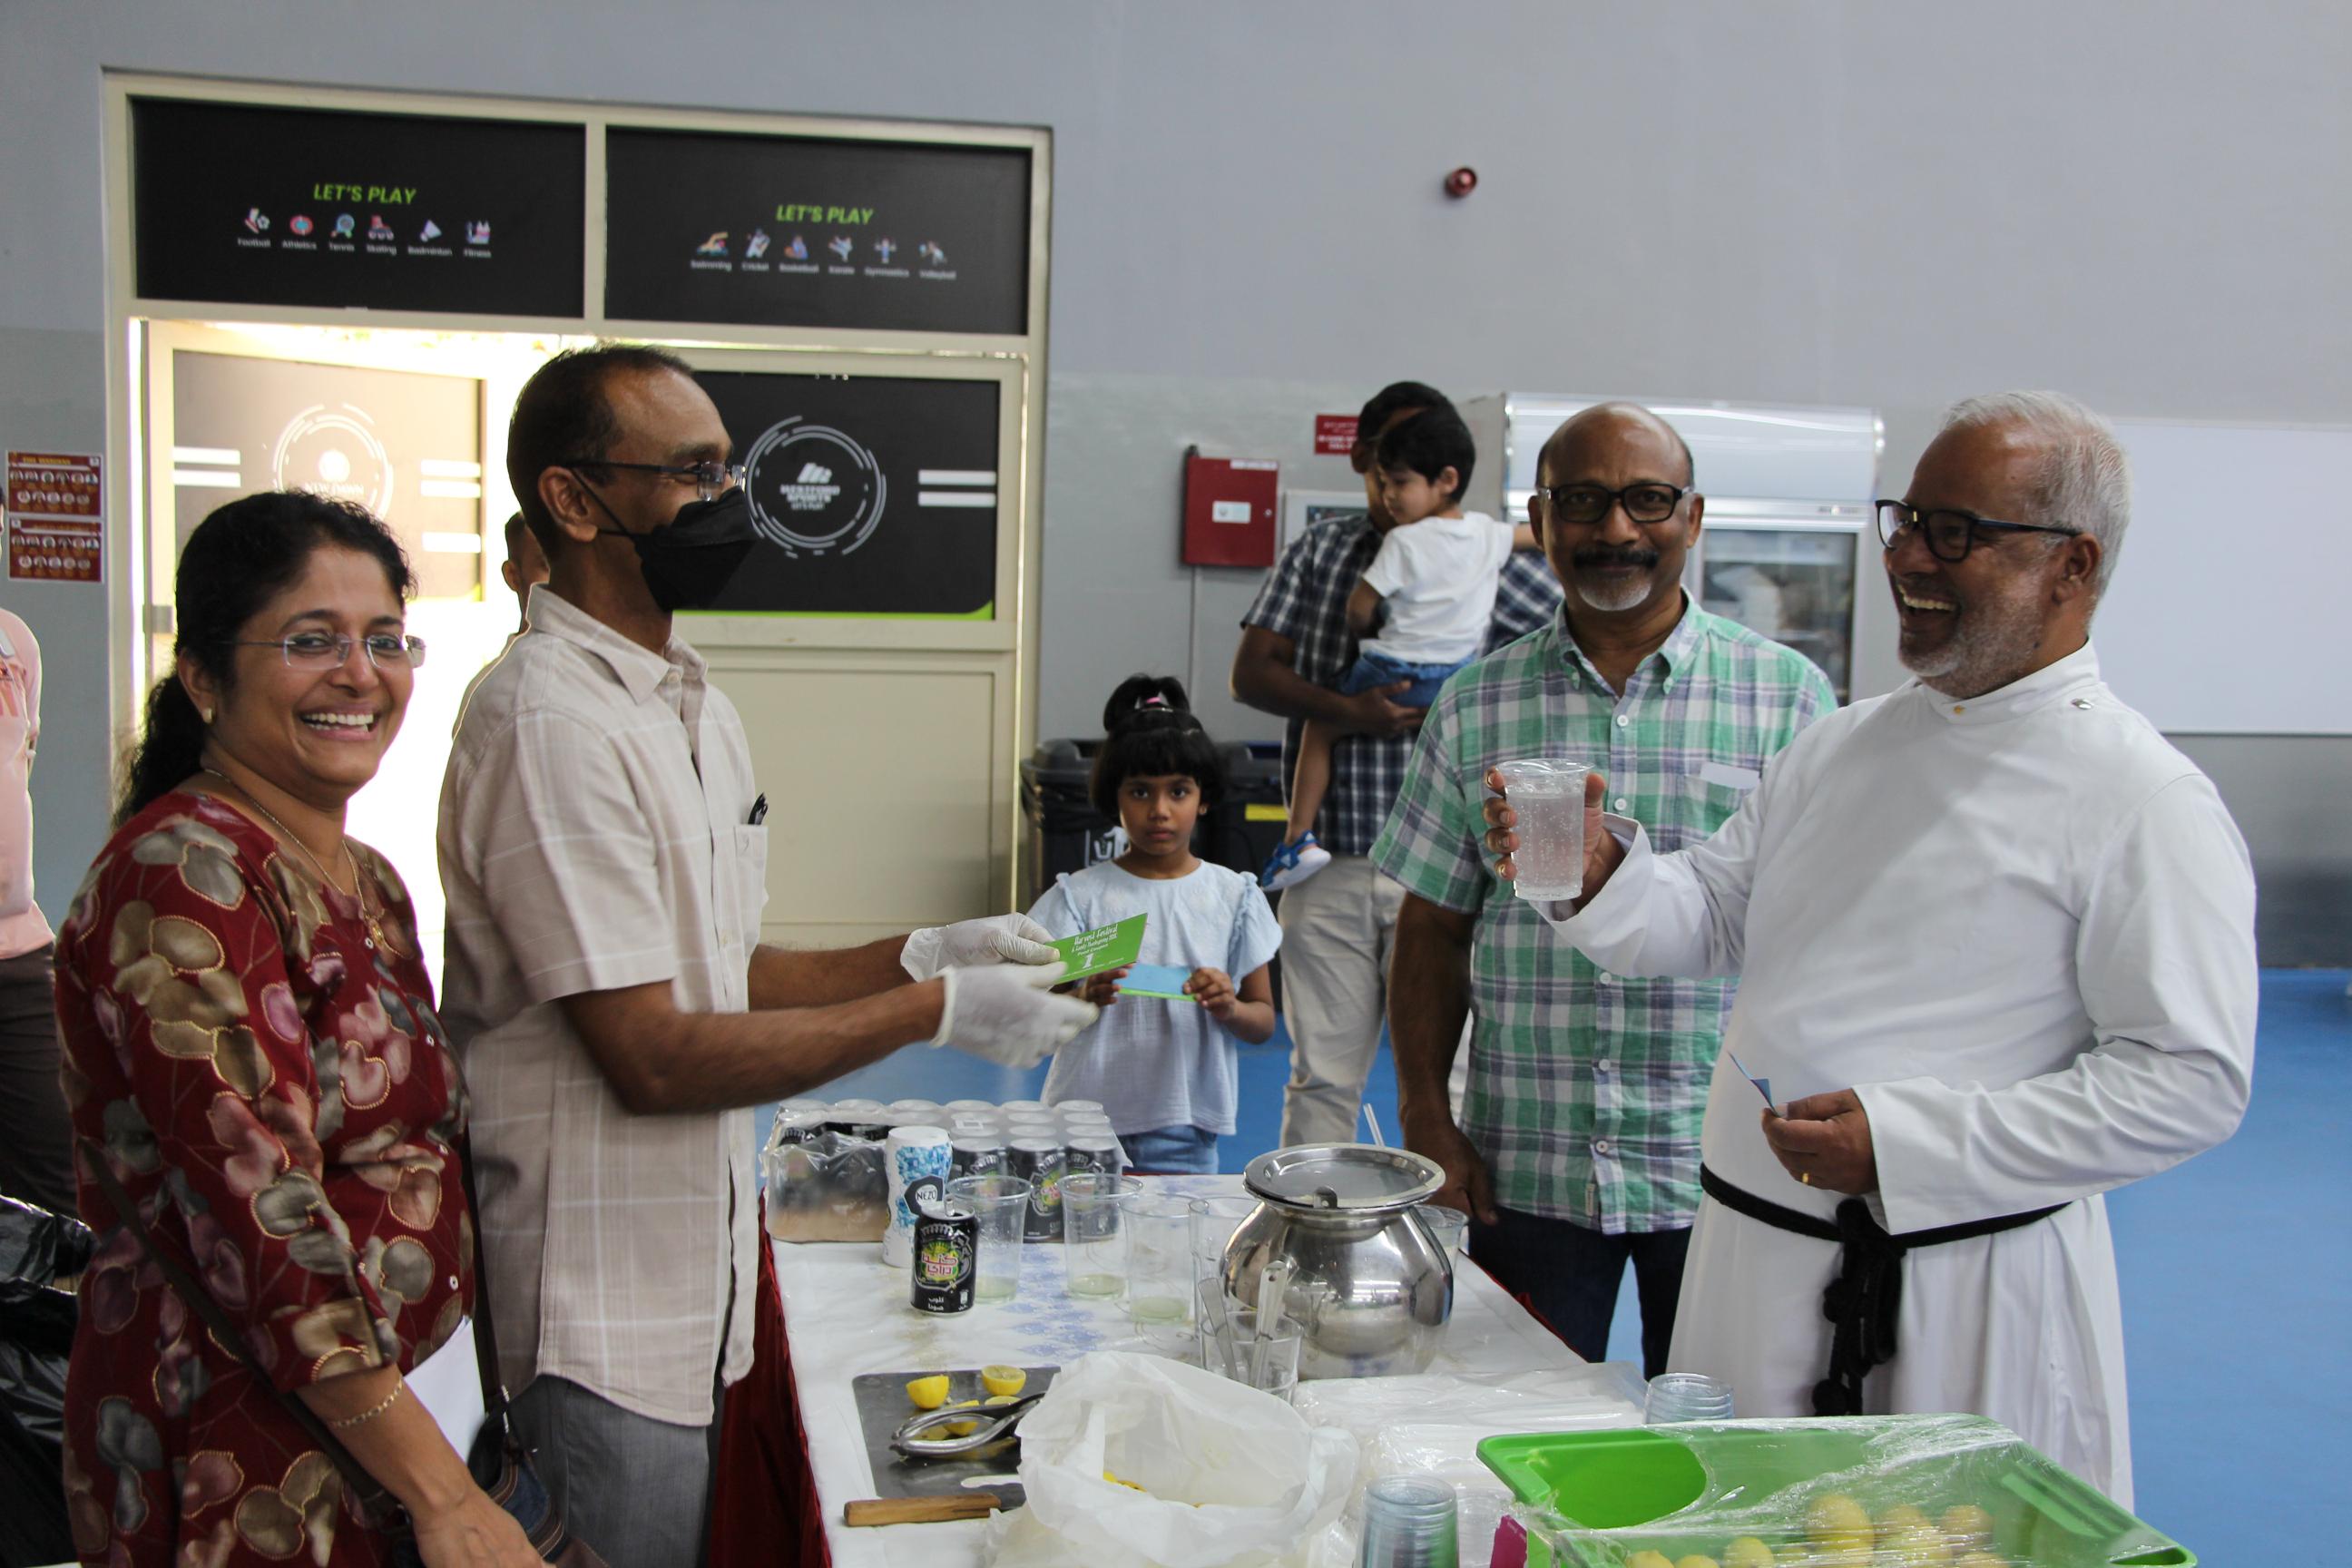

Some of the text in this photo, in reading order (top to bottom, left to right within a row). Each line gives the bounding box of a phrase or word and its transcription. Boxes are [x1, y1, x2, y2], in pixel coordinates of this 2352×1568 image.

[313, 183, 417, 204] LET'S PLAY
[775, 204, 874, 225] LET'S PLAY
[237, 237, 271, 248] Football
[281, 240, 318, 250] Athletics
[328, 242, 355, 252] Tennis
[366, 244, 397, 255] Skating
[407, 246, 453, 256] Badminton
[464, 250, 492, 259] Fitness
[691, 260, 732, 271] Swimming
[779, 263, 819, 274] Basketball
[865, 267, 910, 278] Gymnastics
[1074, 924, 1119, 946] Harvest Festival
[916, 1190, 936, 1200] NEZO
